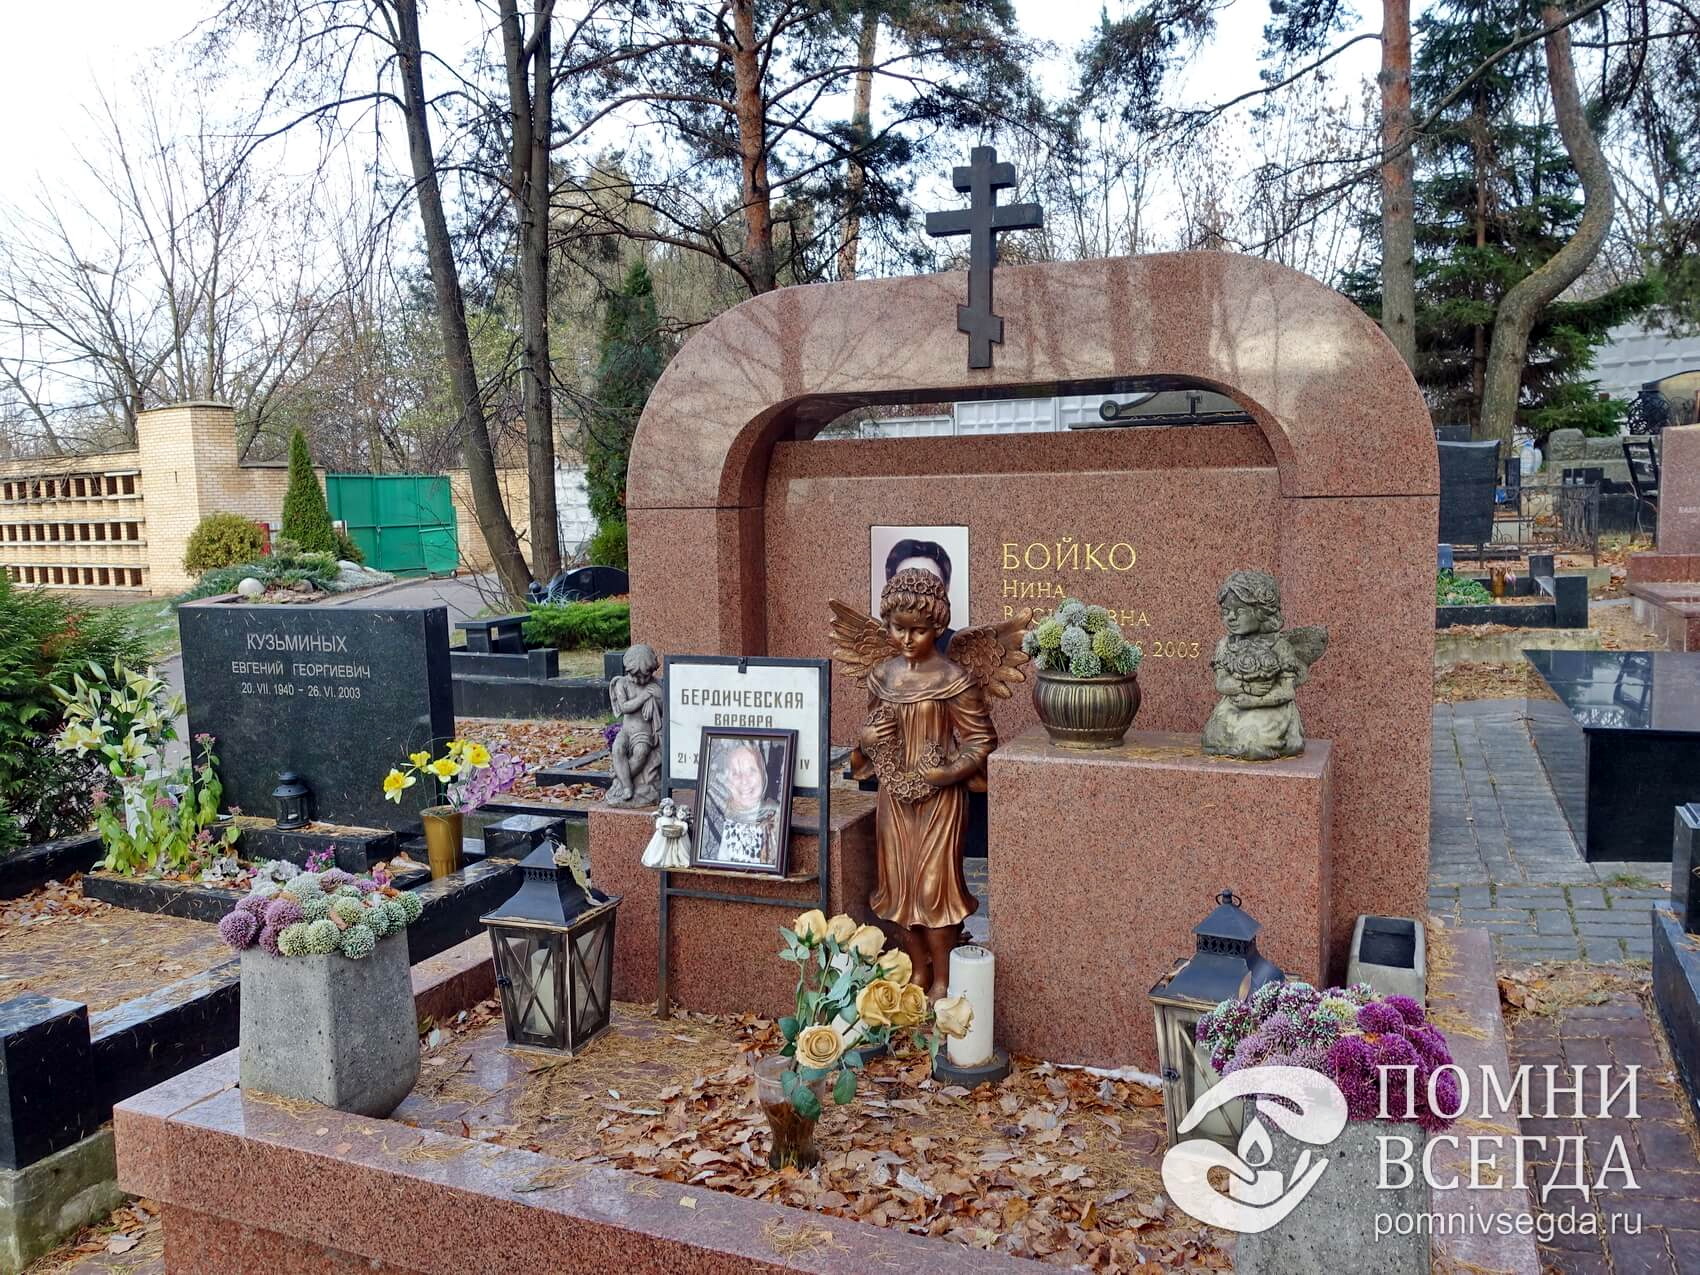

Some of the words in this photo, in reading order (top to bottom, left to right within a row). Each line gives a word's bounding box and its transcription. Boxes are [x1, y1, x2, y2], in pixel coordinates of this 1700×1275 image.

[1002, 537, 1137, 571] БОЙКО
[247, 633, 348, 653] КУЗЬМИНЫХ
[1153, 641, 1200, 658] 2003
[231, 660, 284, 675] ЕВГЕНИЙ
[292, 663, 371, 679] ГЕОРГИЕВИЧ
[273, 684, 295, 696] 1940
[338, 687, 361, 699] 2003
[681, 689, 804, 709] БЕРДИЧЕВСКАЯ
[714, 713, 773, 727] ВАРВАРА
